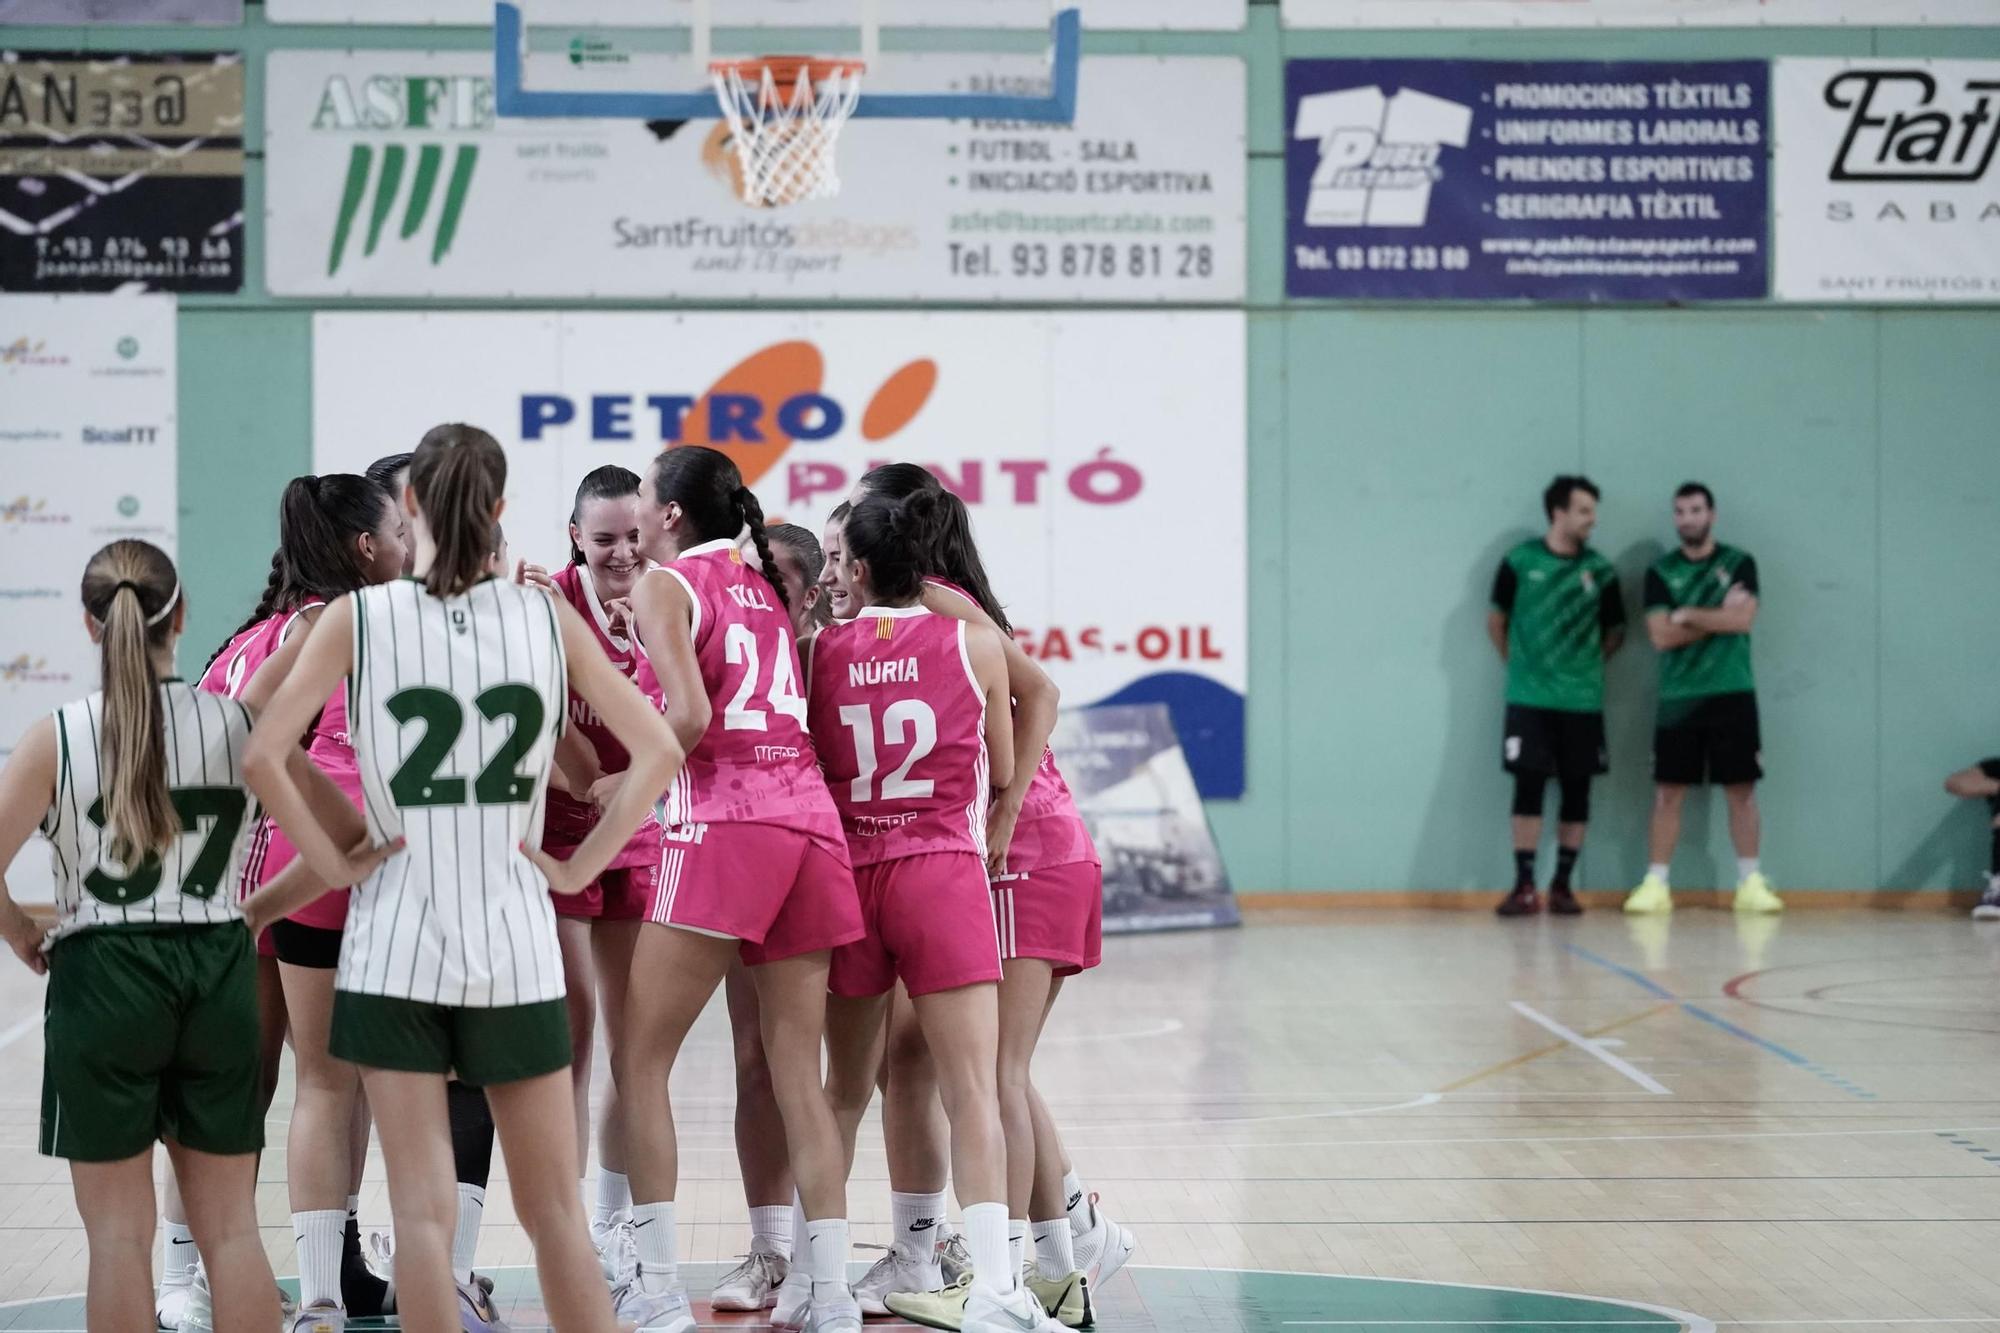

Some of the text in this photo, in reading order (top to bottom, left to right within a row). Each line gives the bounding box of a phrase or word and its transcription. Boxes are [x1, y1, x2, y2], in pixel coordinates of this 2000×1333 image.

[311, 74, 497, 130] ASFE
[1496, 78, 1752, 109] PROMOCIONS TÈXTILS
[1496, 120, 1760, 145] UNIFORMES LABORALS
[968, 141, 1053, 161] FUTBOL
[1080, 141, 1138, 161] SALA
[968, 168, 1213, 193] INICIACIÓ ESPORTIVA
[1496, 157, 1754, 182] PRENDES ESPORTIVES
[1496, 189, 1722, 219] SERIGRAFIA TÈXTIL
[1826, 201, 2000, 222] SABA
[949, 243, 1213, 277] Tel. 93 878 81 28
[1295, 246, 1332, 270] Tel.
[521, 393, 845, 442] PETRO
[788, 445, 1144, 505] PNTÓ
[724, 623, 810, 734] 24
[848, 657, 919, 688] NÚRIA
[384, 682, 546, 807] 22
[839, 699, 938, 803] 12
[914, 1217, 935, 1226] NIKE
